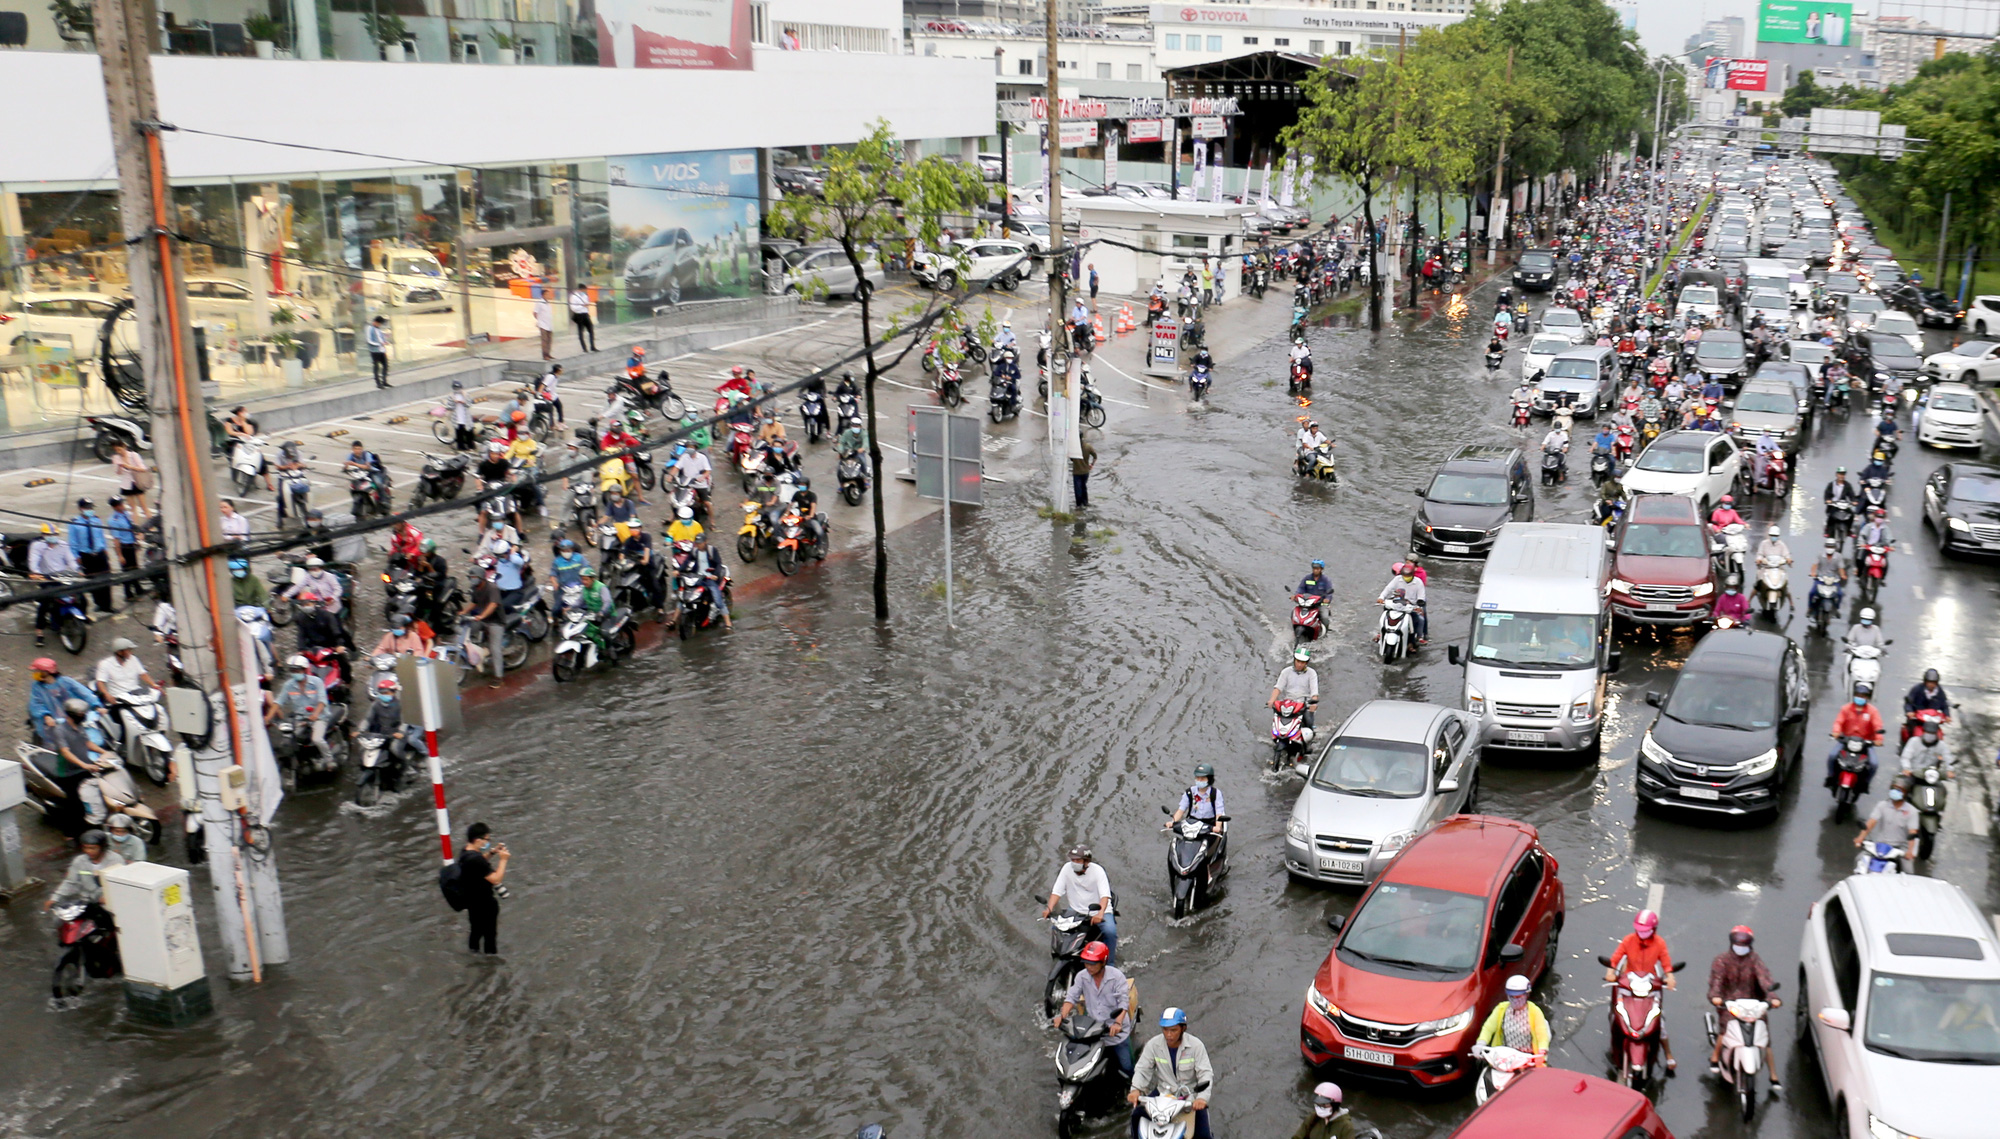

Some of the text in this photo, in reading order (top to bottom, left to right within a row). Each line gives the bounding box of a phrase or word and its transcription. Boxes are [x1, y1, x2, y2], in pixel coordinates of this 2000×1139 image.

[1201, 10, 1248, 23] TOYOTA
[1331, 19, 1353, 28] Toyota
[1355, 20, 1389, 29] Hiroshima
[1031, 97, 1070, 119] TOYTA
[652, 162, 700, 182] VIOS
[1345, 1047, 1393, 1065] 51H-003.13
